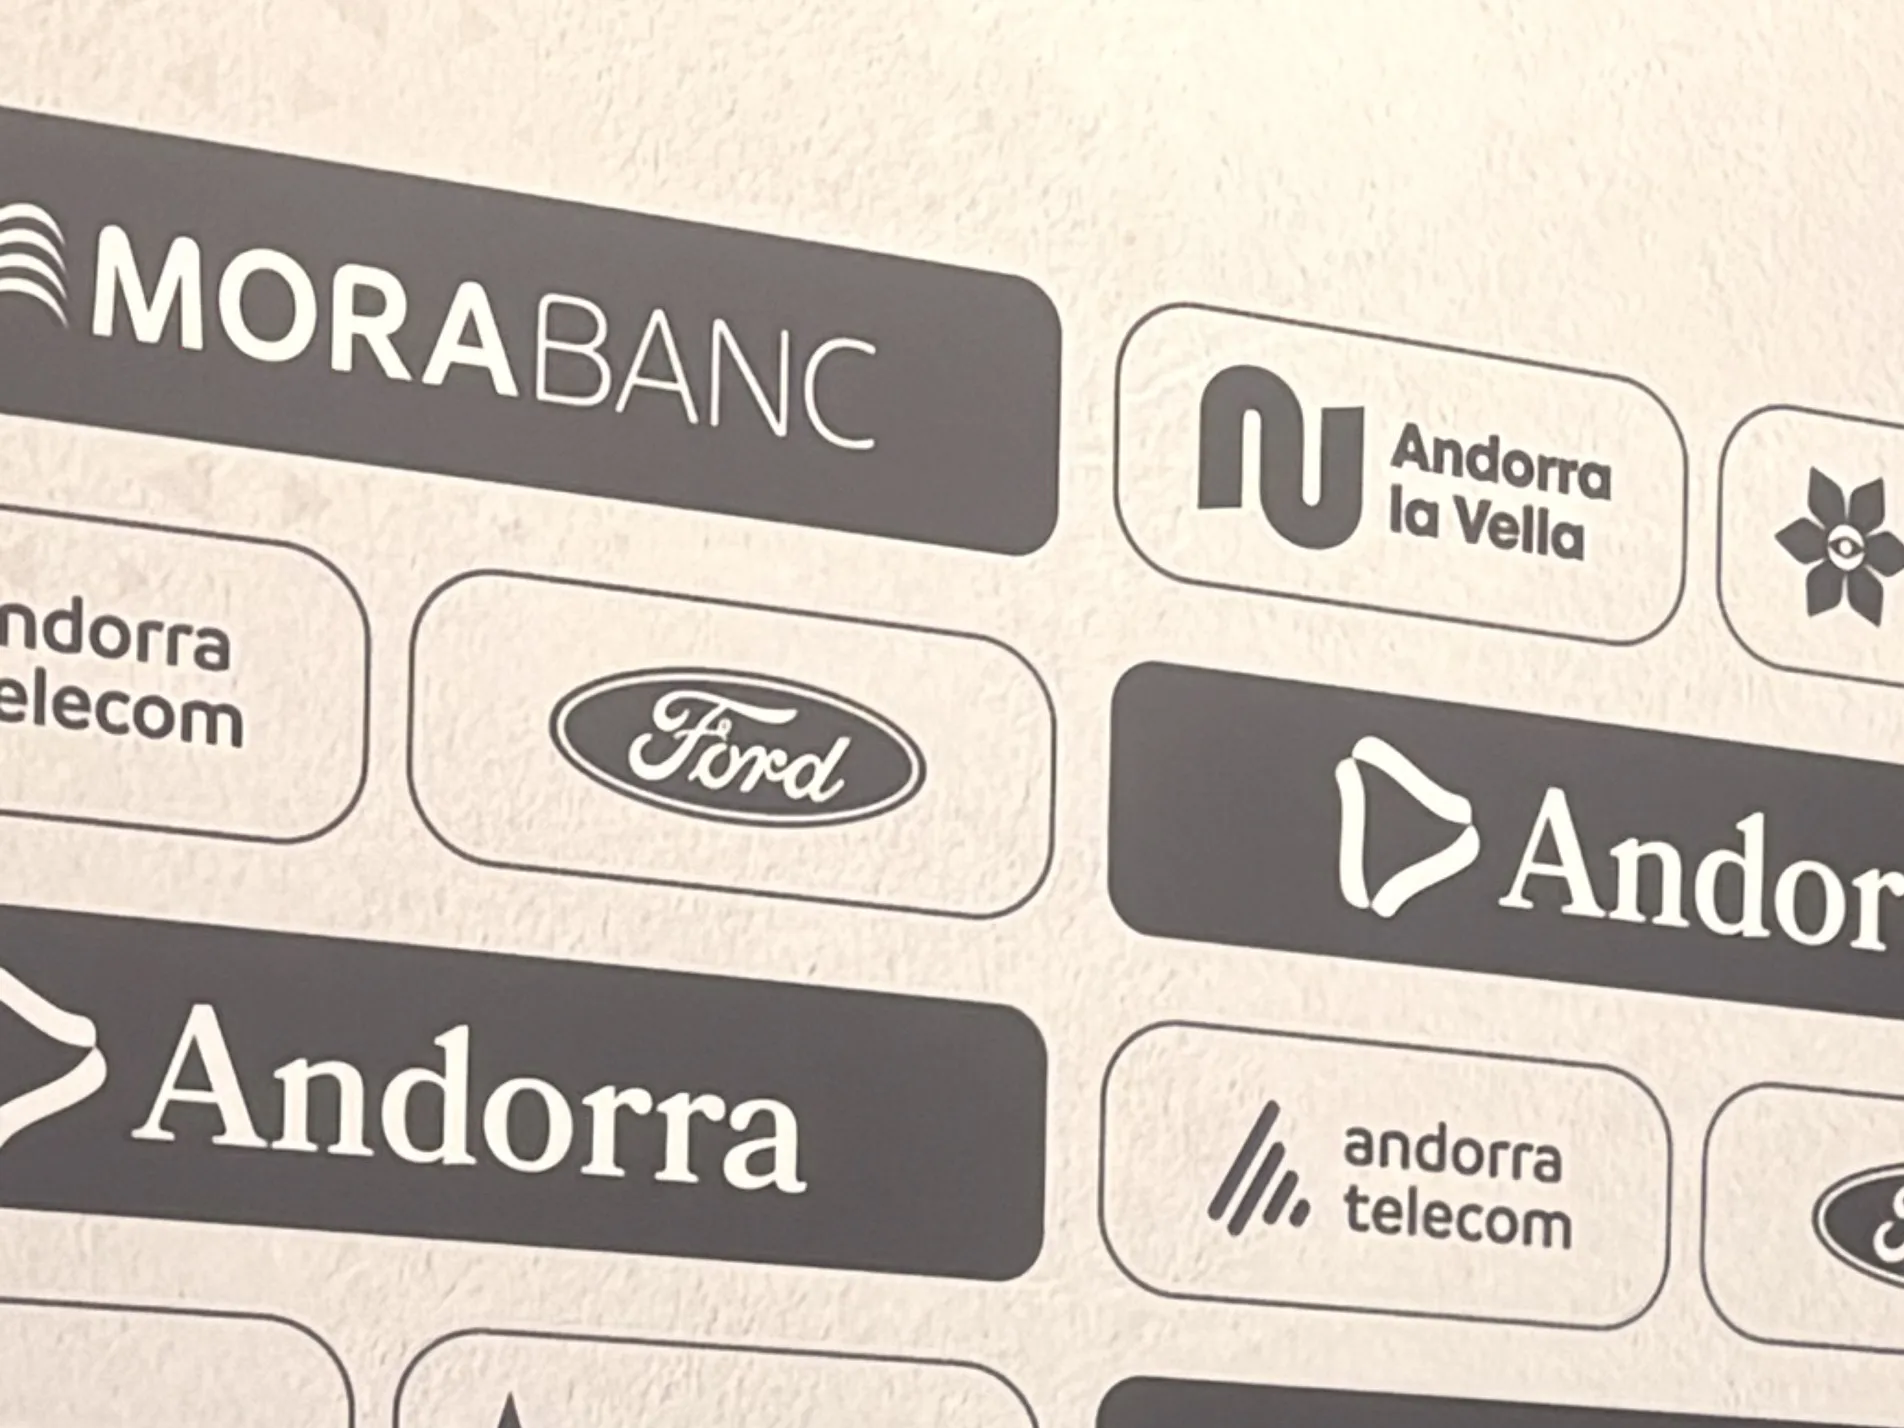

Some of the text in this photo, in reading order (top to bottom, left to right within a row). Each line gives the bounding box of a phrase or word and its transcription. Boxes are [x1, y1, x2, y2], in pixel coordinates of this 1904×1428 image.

[93, 226, 875, 449] MORABANC
[1391, 423, 1611, 500] Andorra
[1391, 484, 1584, 561] la Vella
[0, 596, 230, 672] ndorra
[0, 666, 243, 748] elecom
[628, 690, 852, 803] Ford
[132, 1005, 806, 1193] Andorra
[1345, 1122, 1561, 1183] andorra
[1344, 1185, 1571, 1249] telecom
